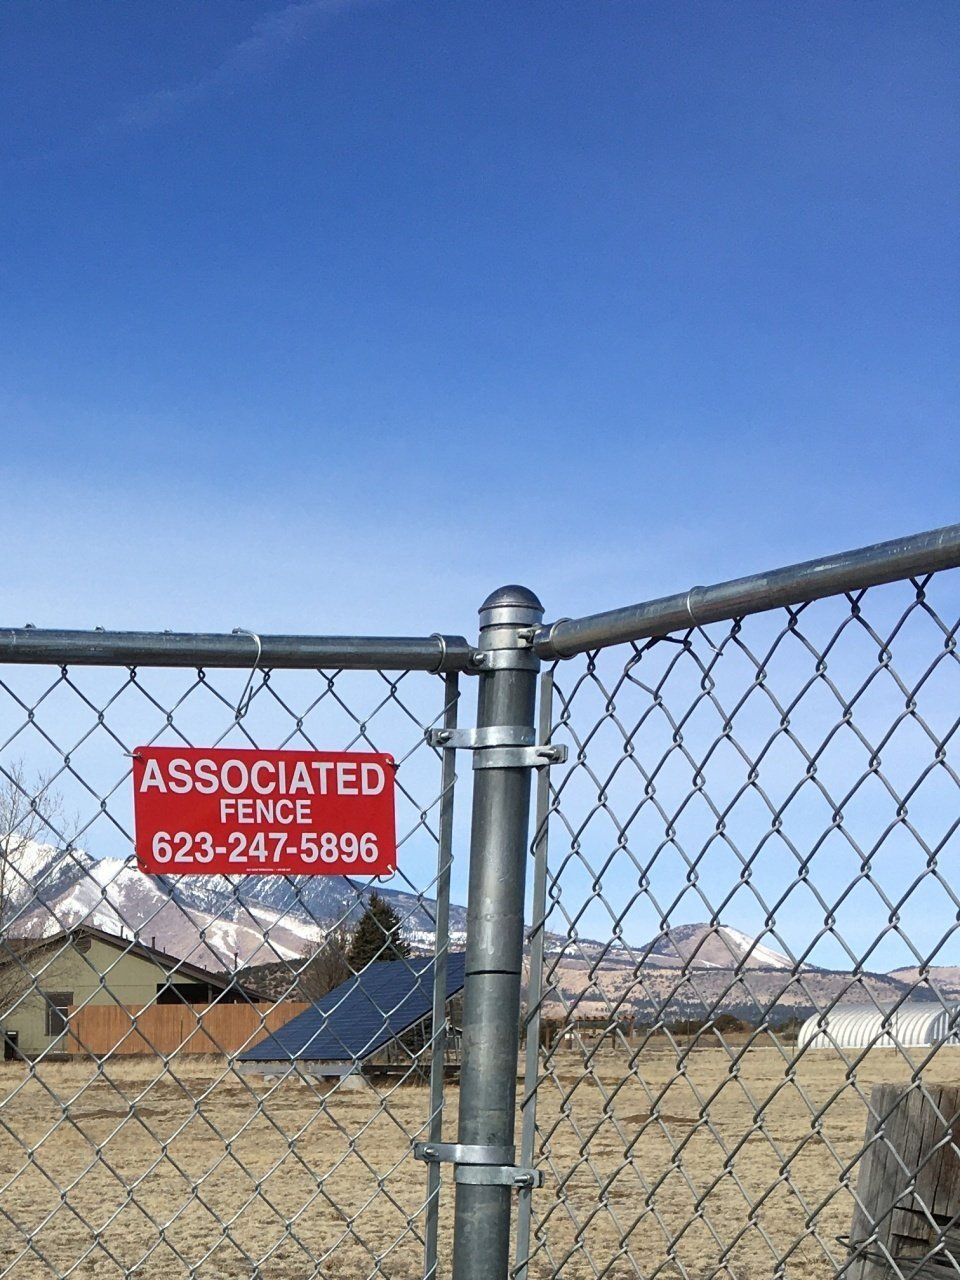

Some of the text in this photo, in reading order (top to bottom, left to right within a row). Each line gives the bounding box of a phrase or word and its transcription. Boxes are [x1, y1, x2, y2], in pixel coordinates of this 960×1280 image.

[140, 758, 385, 795] ASSOCIATED
[220, 799, 313, 824] FENCE
[152, 831, 379, 863] 623-247-5896
